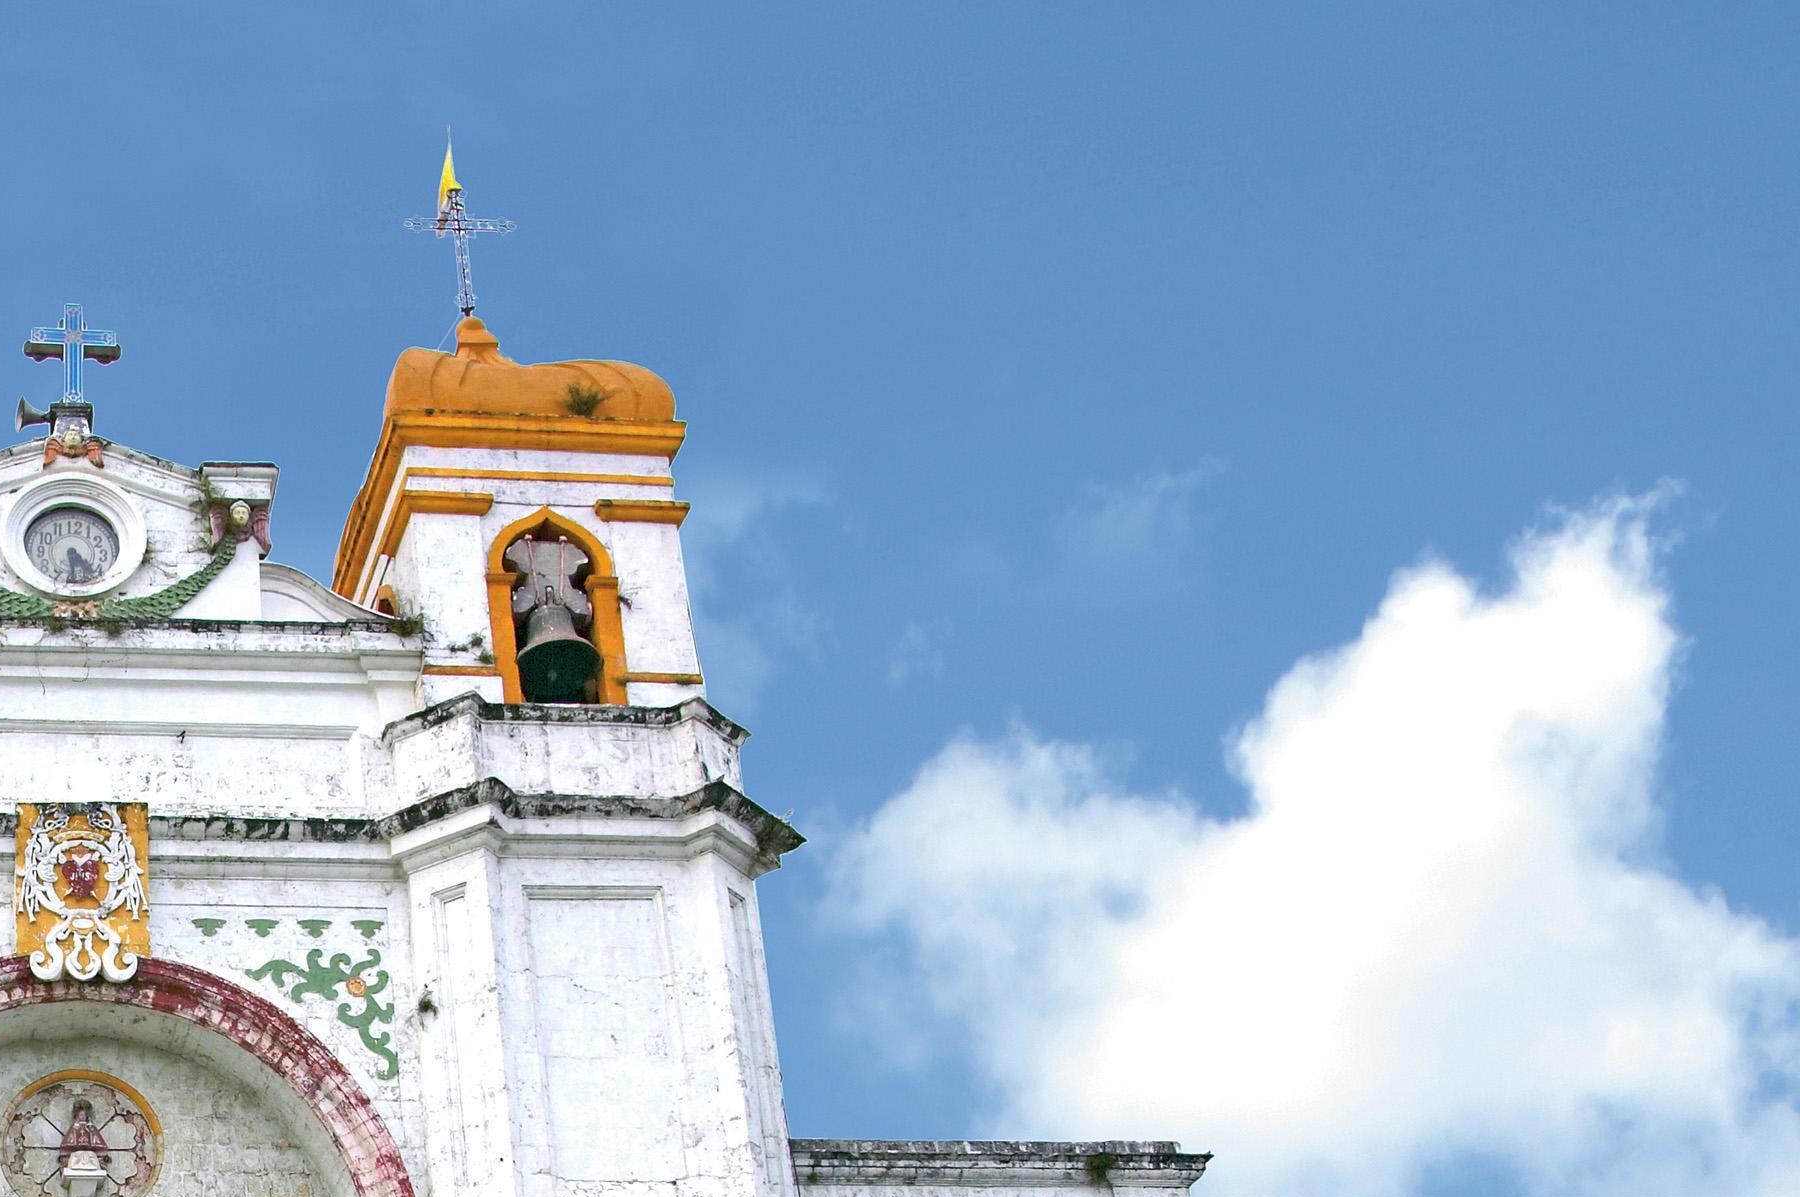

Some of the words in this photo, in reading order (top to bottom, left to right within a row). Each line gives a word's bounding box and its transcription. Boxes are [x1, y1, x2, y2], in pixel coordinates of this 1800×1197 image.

[67, 520, 83, 534] 12
[85, 525, 91, 539] 1
[40, 532, 52, 545] 10
[92, 535, 103, 548] 2
[36, 545, 46, 558] 9
[99, 549, 108, 562] 3
[40, 558, 49, 573] 8
